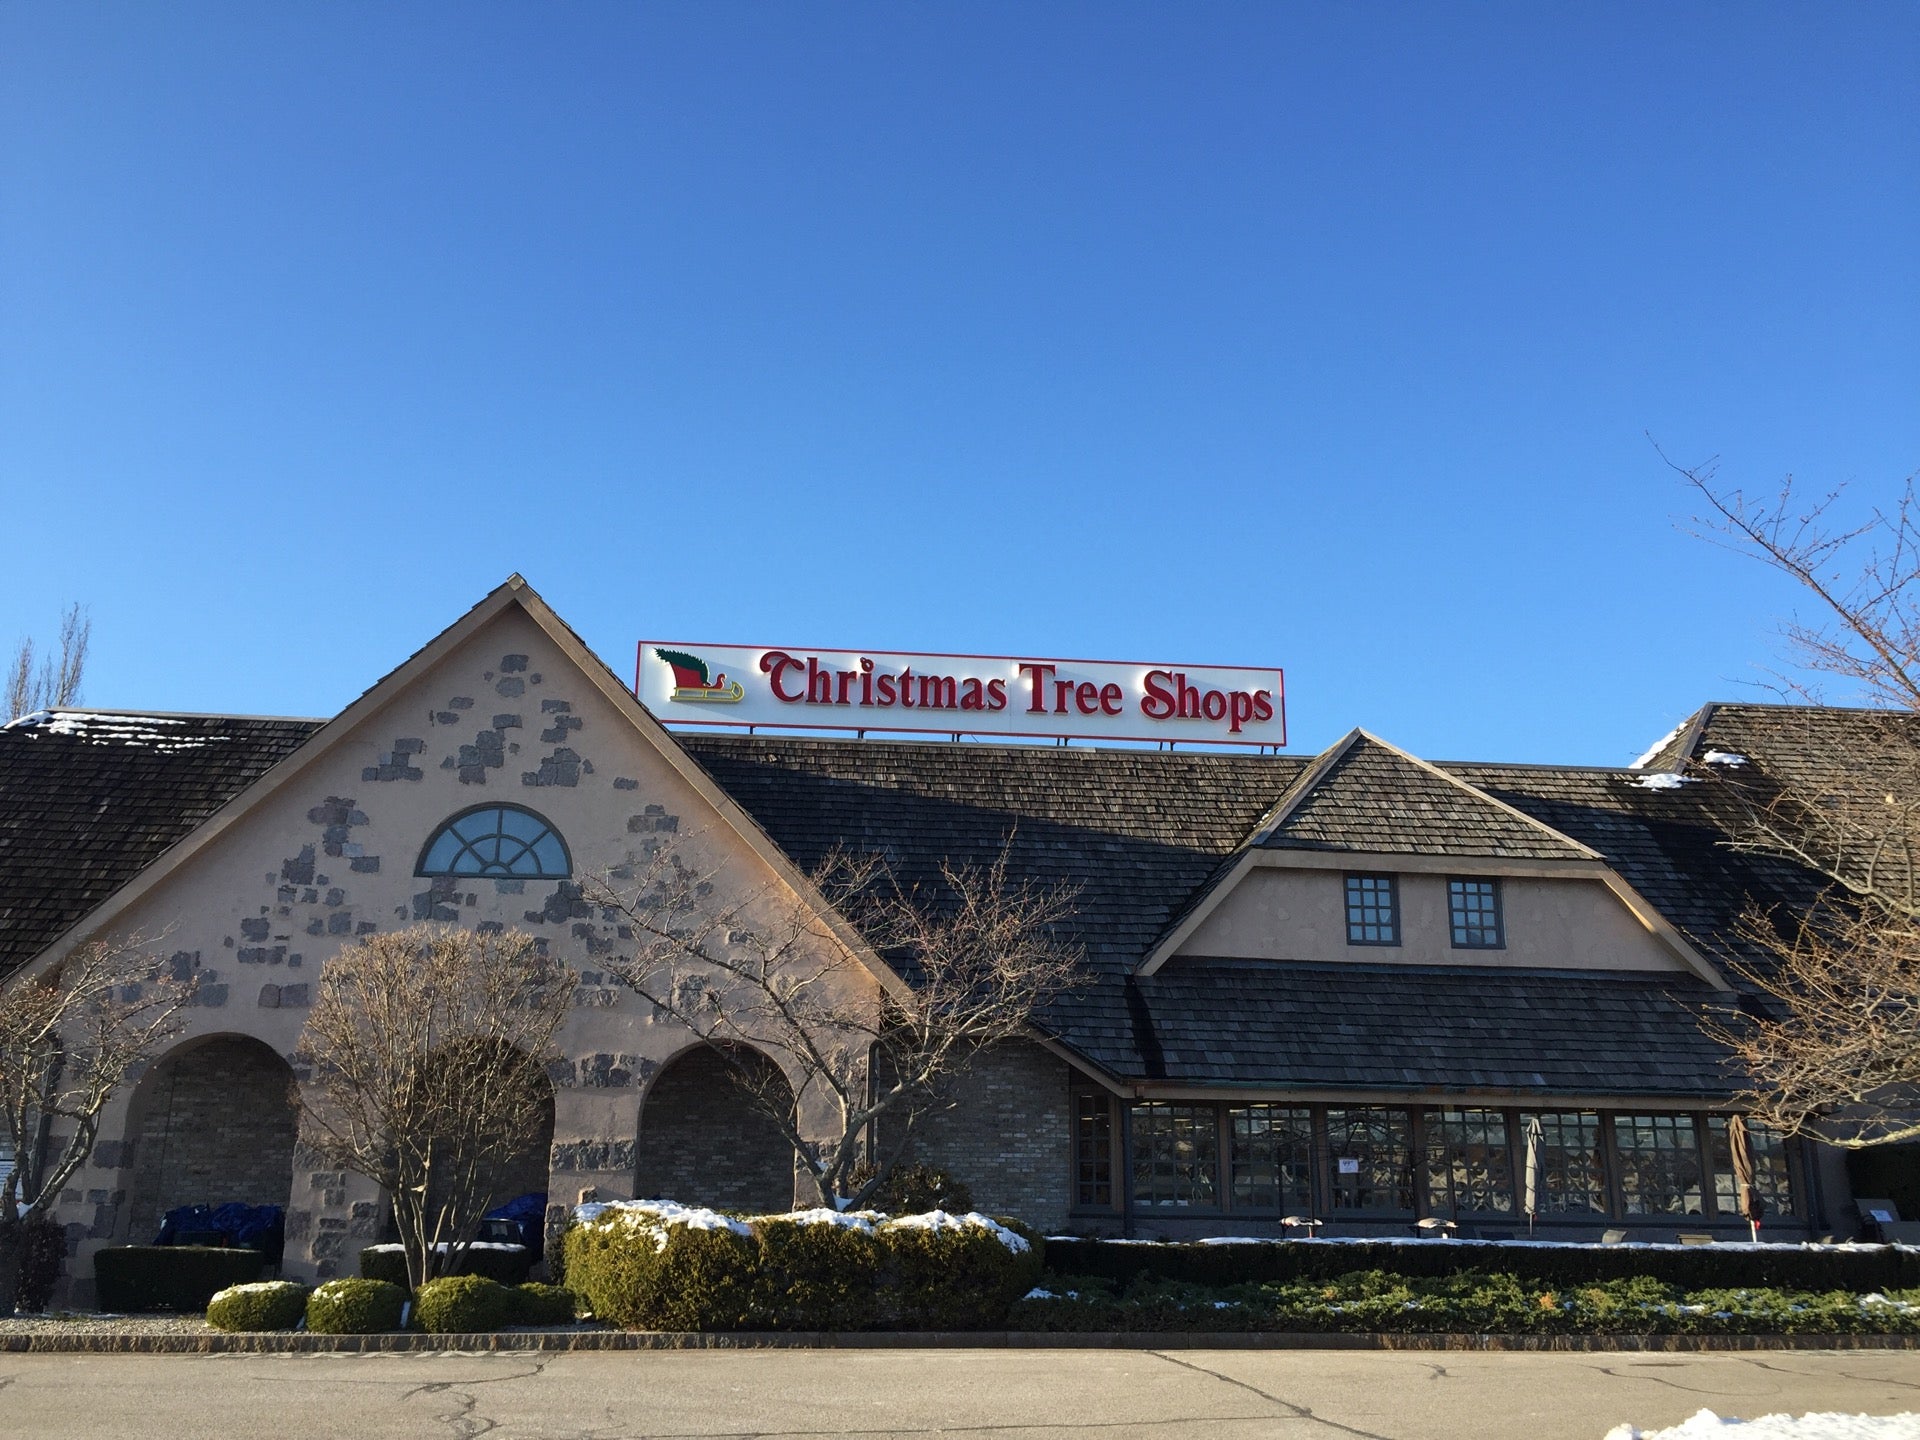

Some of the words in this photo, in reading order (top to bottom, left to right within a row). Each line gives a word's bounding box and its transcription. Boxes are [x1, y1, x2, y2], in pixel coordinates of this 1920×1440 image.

[759, 649, 1007, 711] Christmas
[1018, 664, 1122, 716] Tree
[1140, 670, 1273, 732] Shops
